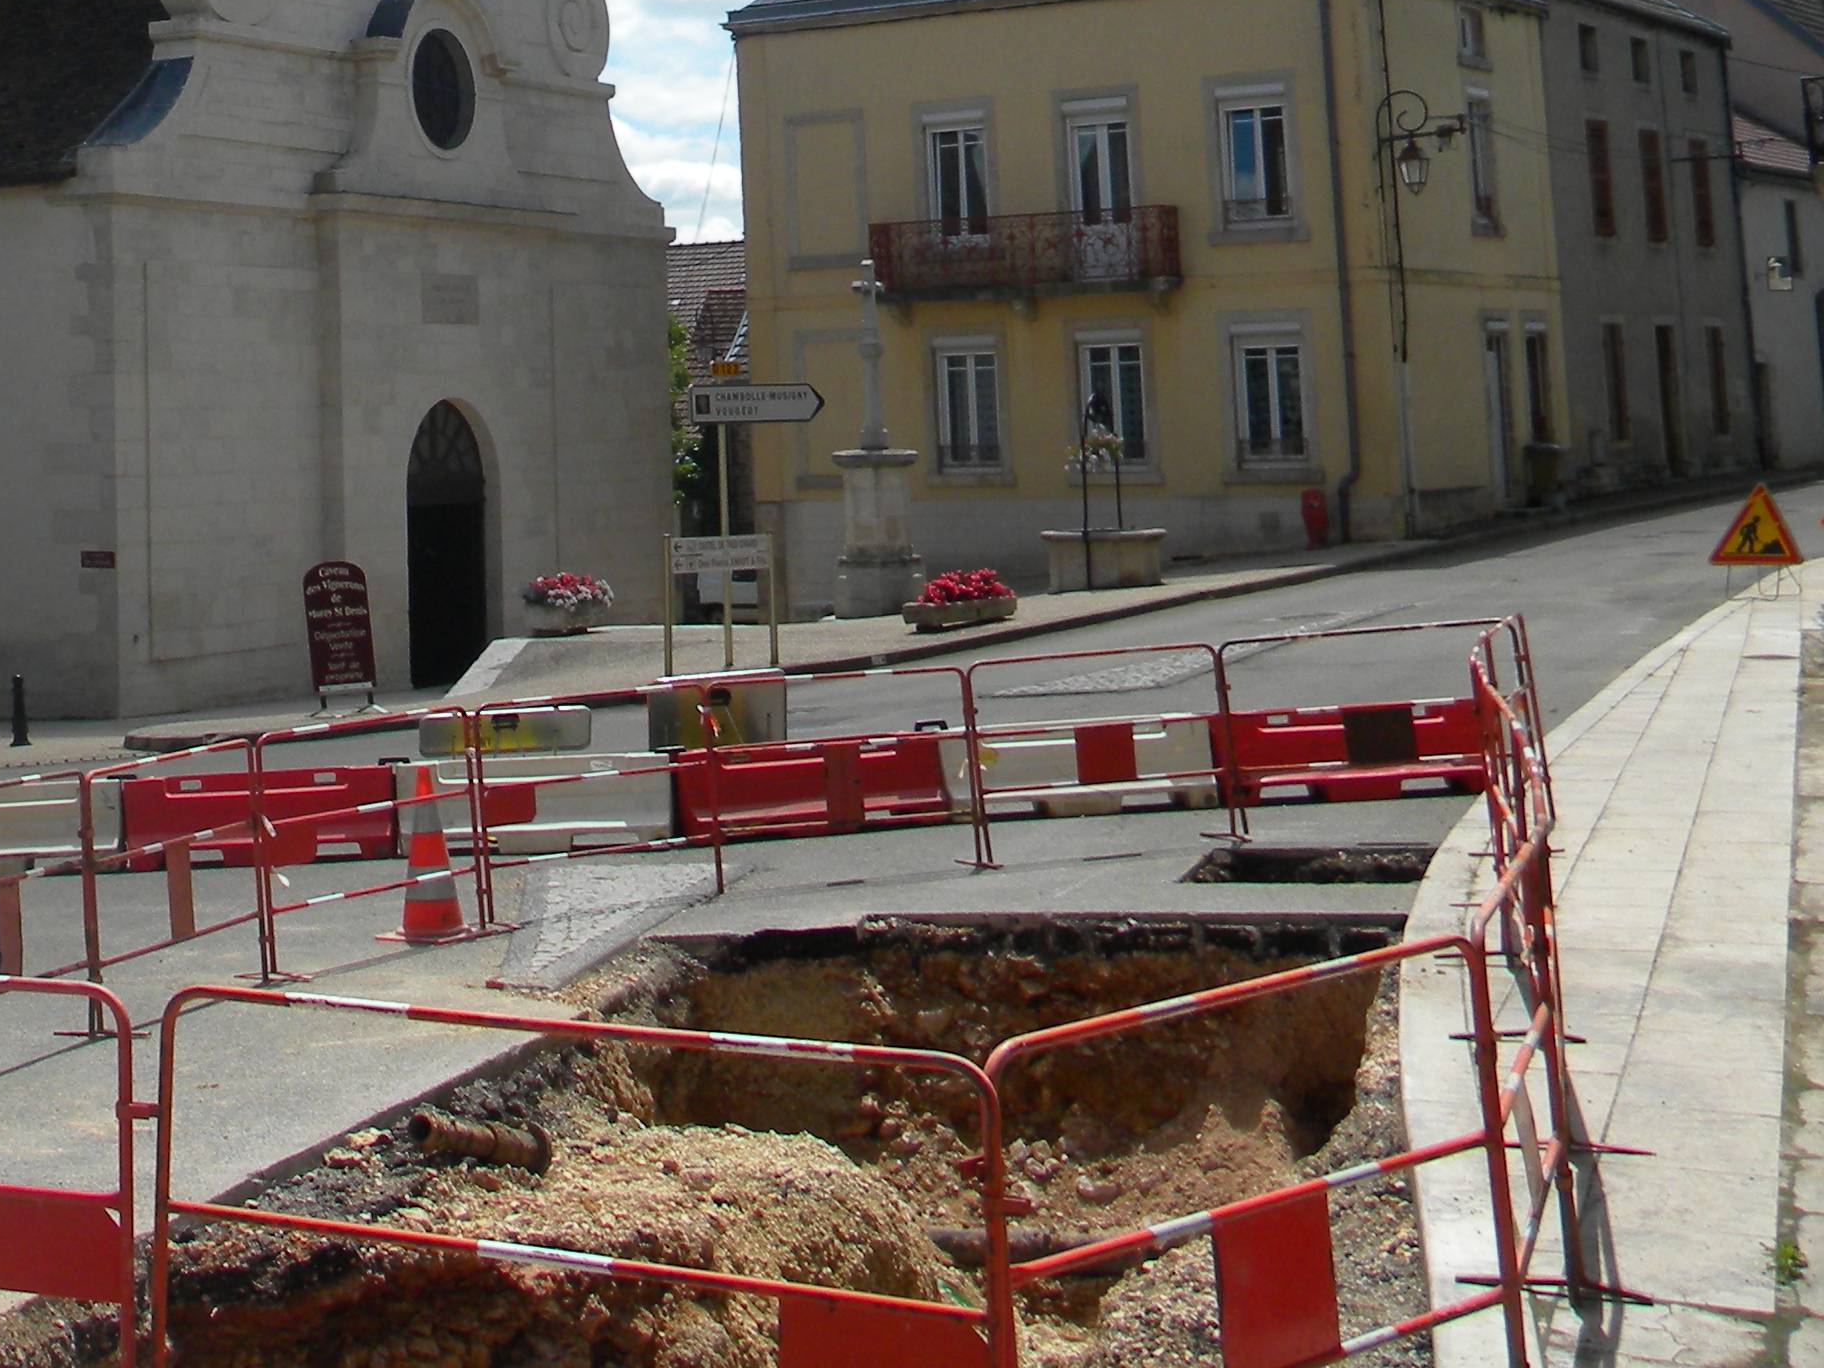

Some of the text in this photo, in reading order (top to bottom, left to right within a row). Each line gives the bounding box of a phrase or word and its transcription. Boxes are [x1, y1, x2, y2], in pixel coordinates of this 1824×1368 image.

[715, 391, 808, 402] CHAMBOLLE-MUSIGNY
[715, 406, 759, 417] VOUGEOT
[319, 566, 350, 578] Caveau
[321, 579, 366, 592] Vignerons
[330, 593, 343, 603] de
